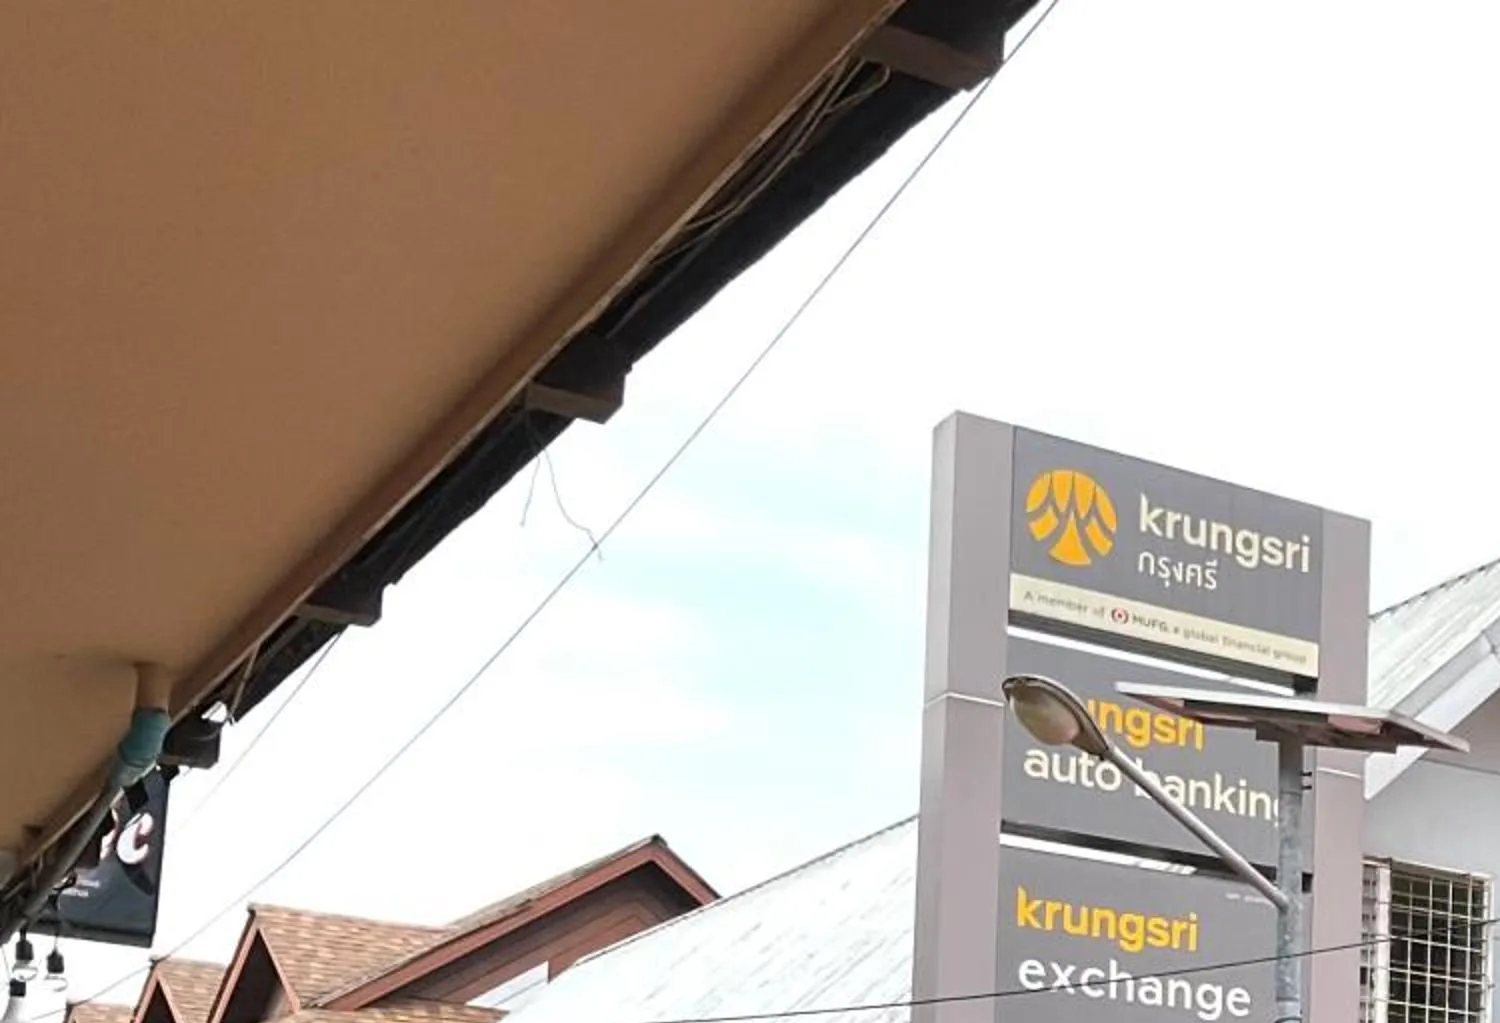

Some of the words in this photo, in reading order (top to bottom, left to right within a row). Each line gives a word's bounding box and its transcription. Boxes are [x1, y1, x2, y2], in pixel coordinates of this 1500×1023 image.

[1139, 492, 1311, 573] krungsri
[1137, 551, 1219, 591] กรุงศรี
[1023, 748, 1122, 790] auto
[1134, 756, 1280, 828] bankin
[1015, 885, 1198, 953] krungsri
[1018, 957, 1251, 1022] exchange
